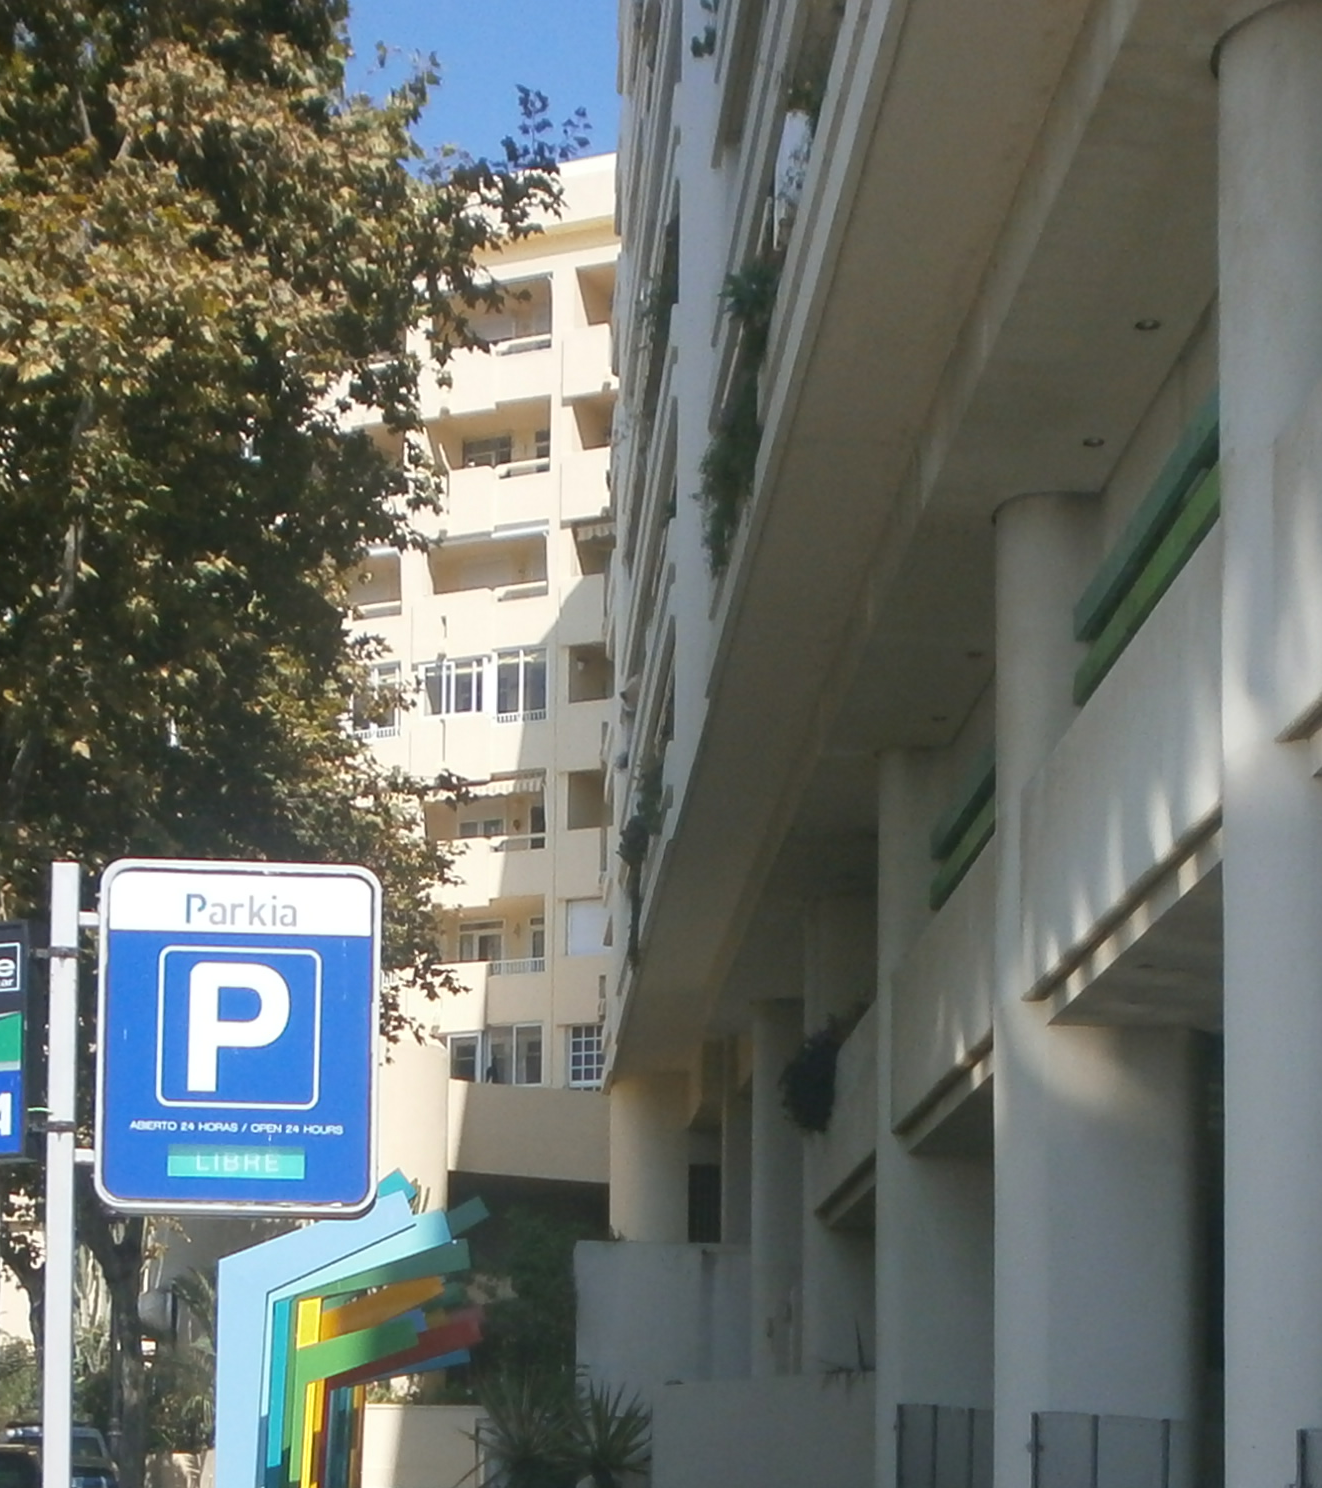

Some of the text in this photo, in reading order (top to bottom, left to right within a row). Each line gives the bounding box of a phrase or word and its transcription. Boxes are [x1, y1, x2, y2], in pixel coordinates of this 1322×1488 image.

[185, 893, 298, 928] Parkia
[187, 961, 291, 1093] P
[129, 1119, 178, 1131] ABIERTO
[180, 1121, 195, 1131] 24
[198, 1121, 238, 1133] HORAS
[250, 1123, 282, 1134] OPEN
[285, 1124, 300, 1134] 24
[303, 1124, 344, 1136] HOURS
[195, 1150, 279, 1173] LIBRE
